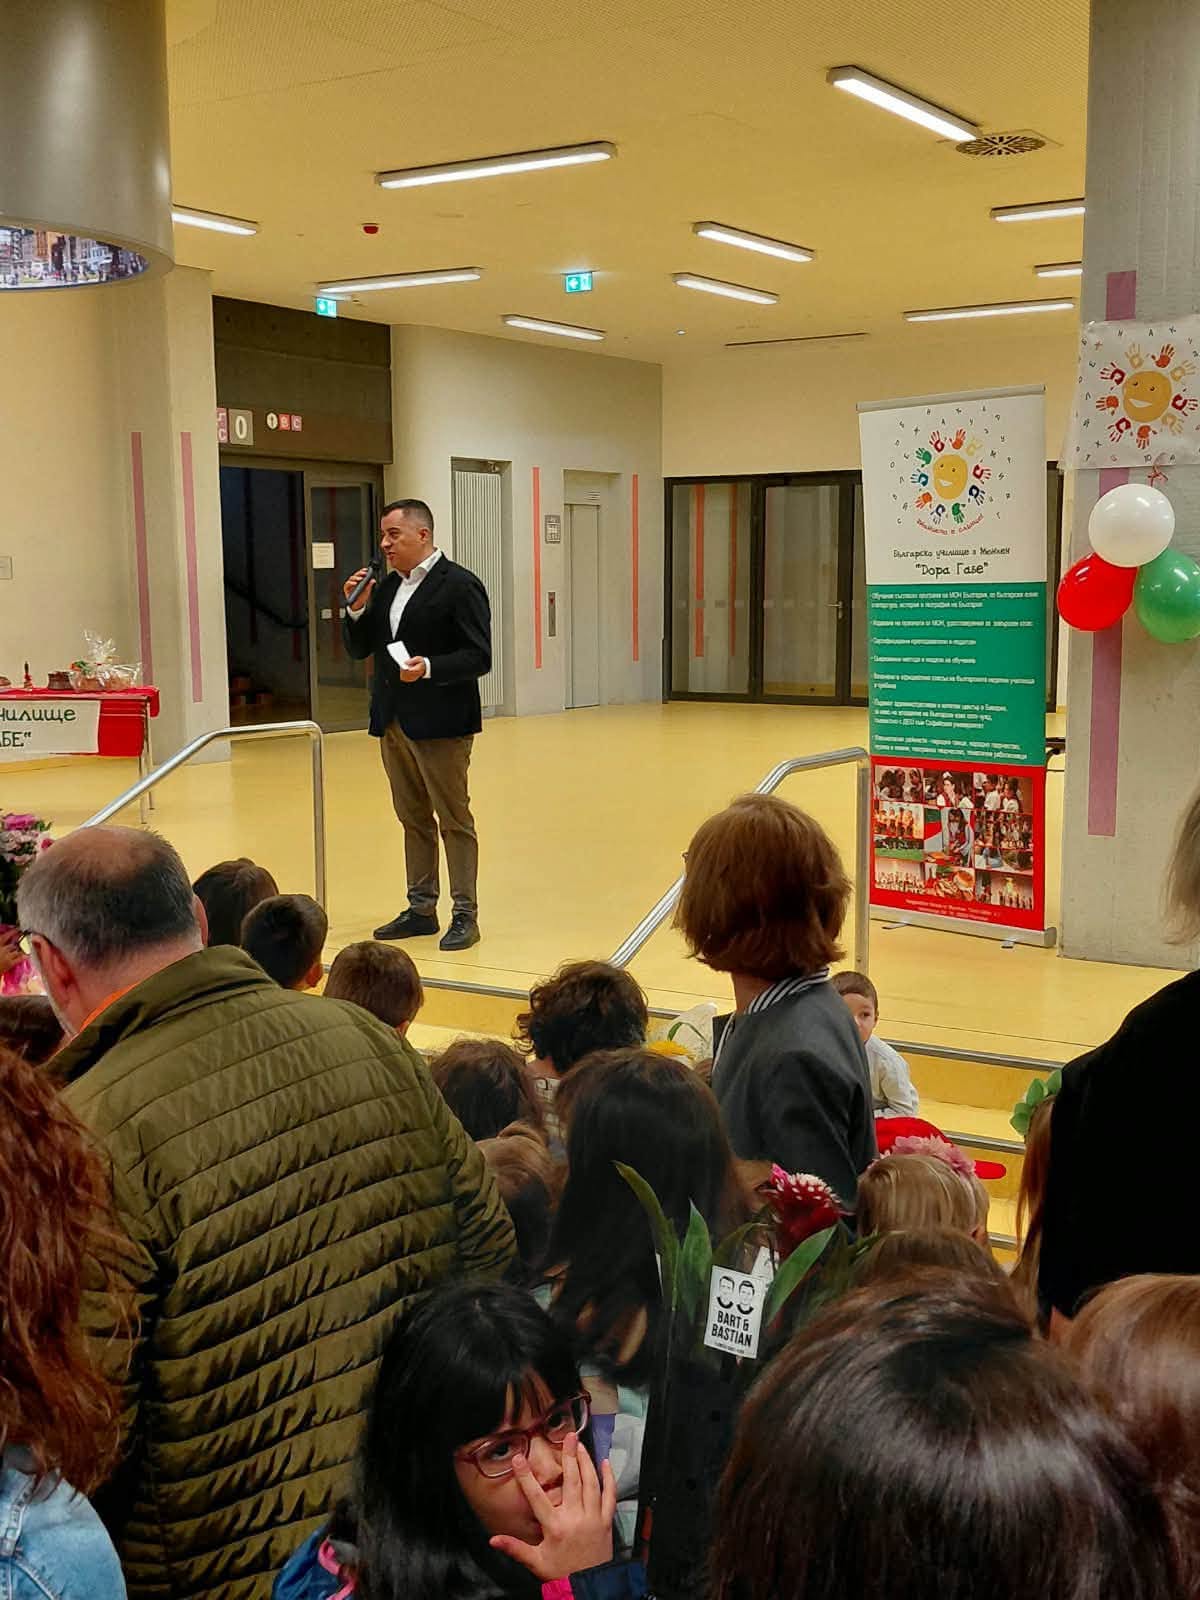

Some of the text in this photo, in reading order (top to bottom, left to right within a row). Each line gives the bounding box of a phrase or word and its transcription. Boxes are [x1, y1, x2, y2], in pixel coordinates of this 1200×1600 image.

[717, 1311, 750, 1331] BART &
[711, 1323, 753, 1347] BASTIAN
